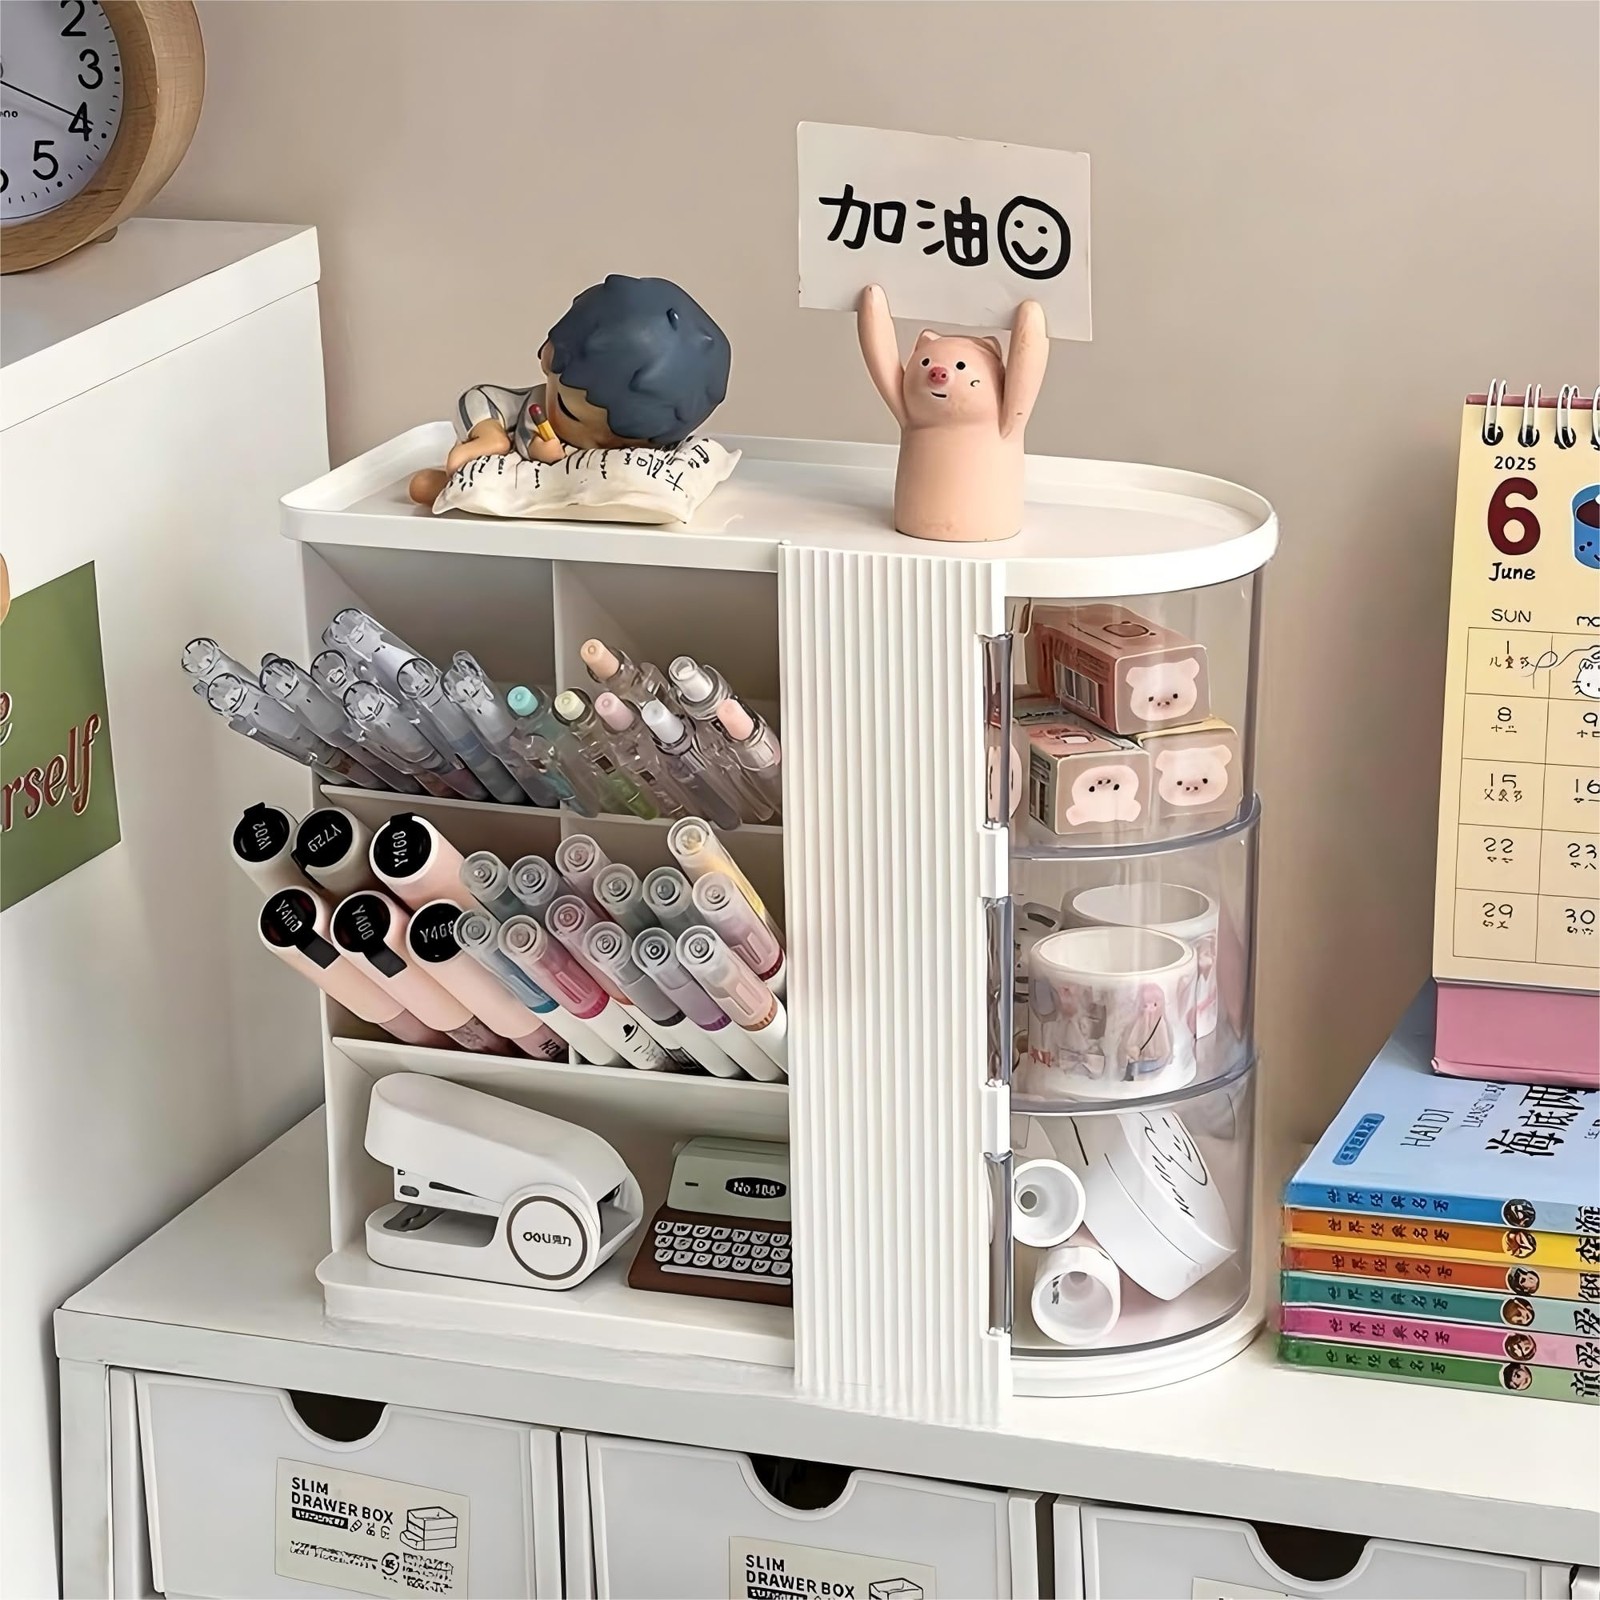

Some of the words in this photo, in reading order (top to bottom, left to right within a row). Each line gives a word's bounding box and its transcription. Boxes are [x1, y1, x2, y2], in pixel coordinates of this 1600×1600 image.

[60, 0, 87, 36] 2
[78, 48, 103, 89] 3
[68, 101, 94, 141] 4
[33, 140, 58, 180] 5
[818, 183, 989, 267] 加油
[1494, 456, 1536, 470] 2025
[1487, 477, 1541, 556] 6
[1488, 562, 1536, 581] June
[1491, 609, 1531, 622] SUN
[1497, 707, 1512, 722] 8
[1583, 712, 1599, 727] 9
[1490, 773, 1517, 789] 15
[1575, 779, 1600, 795] 16
[1483, 837, 1514, 853] 22
[1567, 843, 1597, 859] 23
[1482, 902, 1513, 918] 29
[1565, 908, 1596, 924] 30
[1485, 1085, 1598, 1156] 海底两
[291, 1476, 328, 1495] SLIM
[291, 1491, 358, 1517] DRAWER
[361, 1506, 394, 1525] BOX
[745, 1554, 785, 1572] SLIM
[746, 1569, 817, 1593] DRAWER
[821, 1581, 855, 1599] BOX
